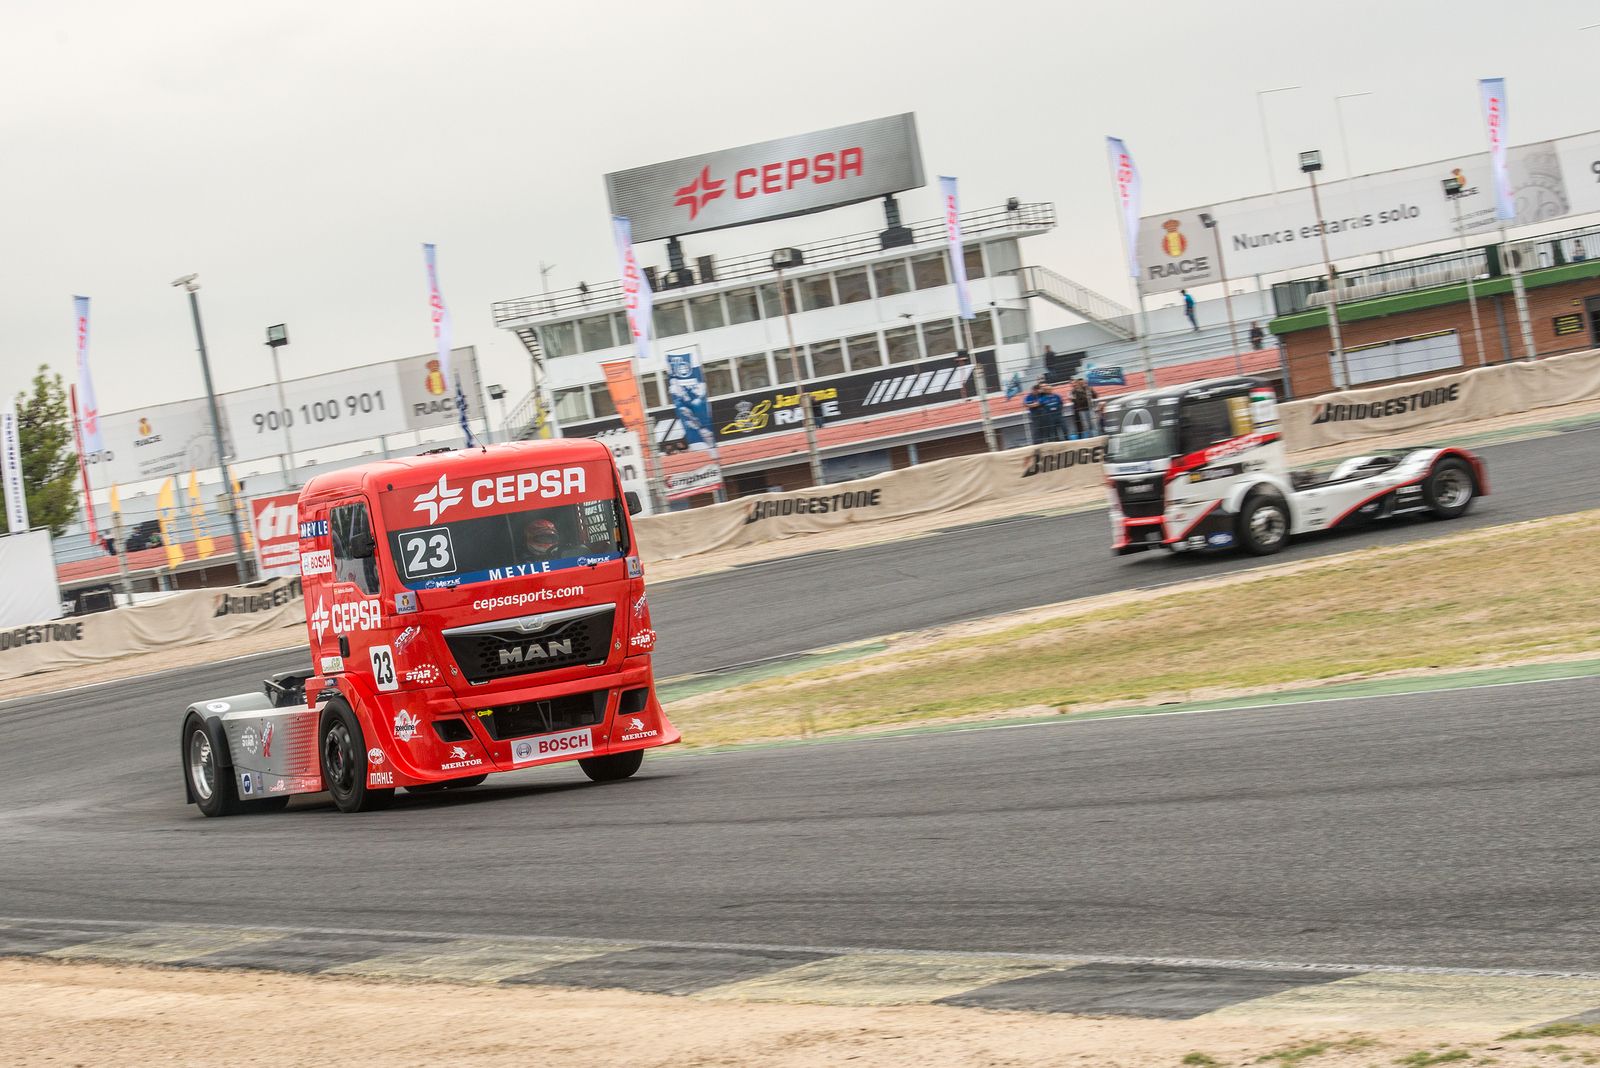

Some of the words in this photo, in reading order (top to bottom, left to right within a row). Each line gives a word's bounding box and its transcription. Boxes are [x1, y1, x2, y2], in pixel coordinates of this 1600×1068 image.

[735, 147, 863, 200] CEPSA
[1232, 227, 1295, 251] Nunca
[1378, 203, 1421, 224] solo
[1148, 256, 1210, 280] RACE
[253, 408, 293, 433] 900
[301, 399, 340, 425] 100
[346, 390, 386, 416] 901
[774, 400, 841, 426] RAE
[1312, 383, 1460, 424] BRIDGESTONE
[1022, 446, 1109, 478] BRIDGE
[472, 467, 586, 508] CEPSA
[746, 487, 881, 524] BRIDGESTONE
[300, 520, 328, 538] MEYLE
[310, 555, 331, 569] BOSCH
[407, 534, 451, 573] 23
[489, 561, 551, 582] MEYLE
[473, 585, 584, 611] cepsasports.com
[331, 599, 381, 634] CEPSA
[498, 639, 573, 665] MAN
[631, 634, 651, 646] STAR
[373, 651, 393, 685] 23
[406, 670, 430, 681] STAR
[538, 734, 589, 754] BOSCH
[621, 729, 658, 741] MERITOR
[441, 758, 483, 770] MERITOR
[370, 772, 394, 784] MAHLE
